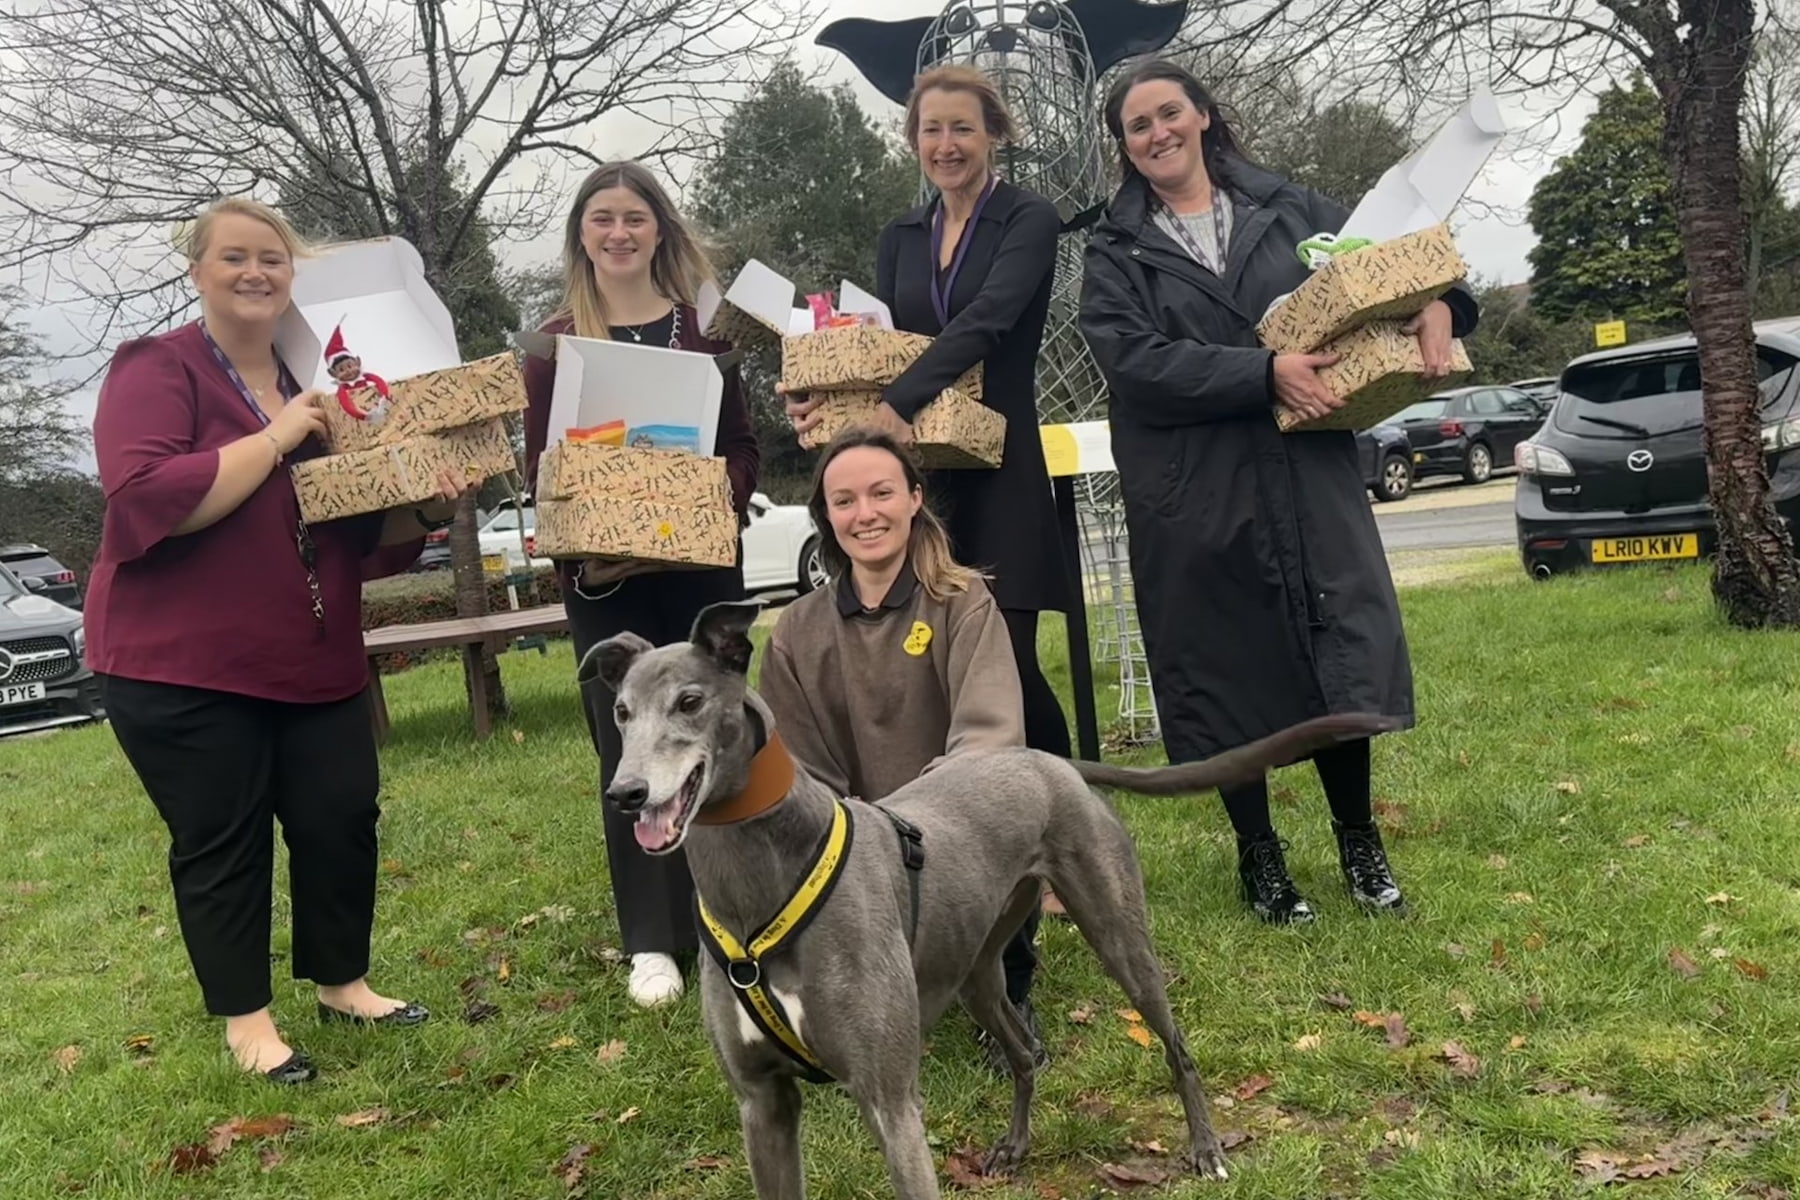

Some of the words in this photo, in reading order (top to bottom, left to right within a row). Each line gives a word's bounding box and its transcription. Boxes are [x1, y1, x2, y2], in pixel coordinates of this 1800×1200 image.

[1604, 540, 1643, 558] LR10
[1648, 536, 1684, 555] KWV
[8, 685, 38, 701] PYE
